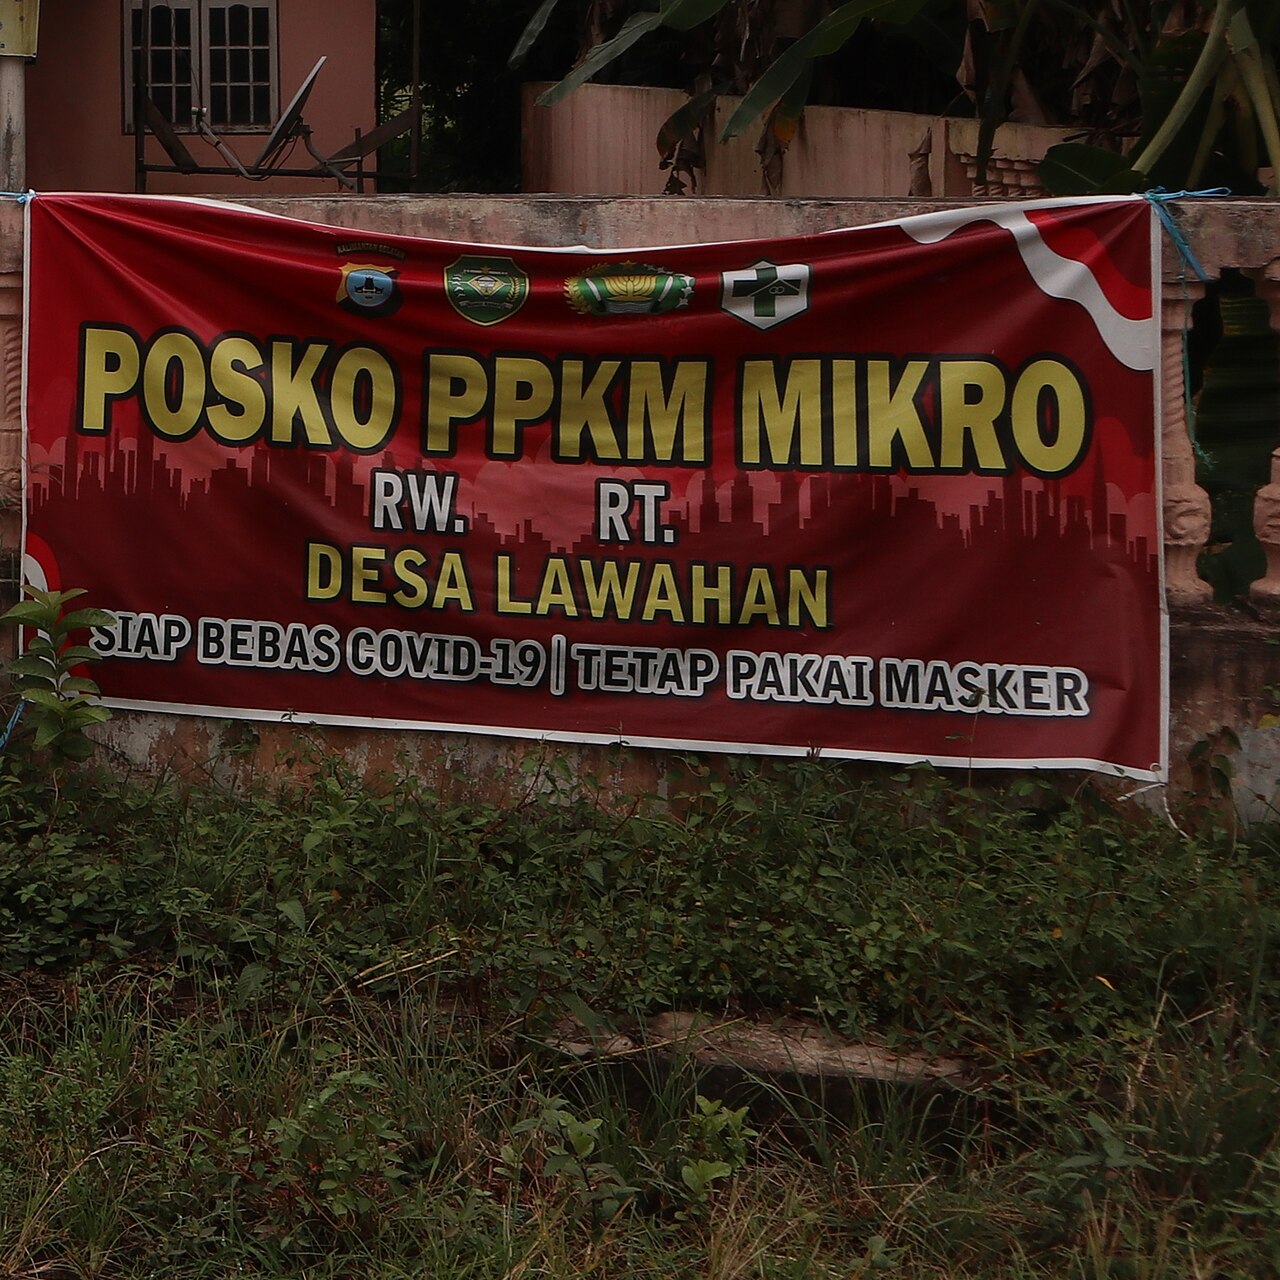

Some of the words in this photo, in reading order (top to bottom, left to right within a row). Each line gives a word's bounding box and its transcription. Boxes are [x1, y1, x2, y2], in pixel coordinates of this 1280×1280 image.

[80, 325, 398, 451] POSKO
[425, 351, 709, 463] PPKM
[740, 358, 1089, 474] MIKRO
[372, 471, 466, 535] RW.
[598, 481, 676, 544] RT.
[306, 541, 475, 613] DESA
[496, 554, 830, 630] LAWAHAN
[91, 612, 192, 661] SIAP
[198, 619, 339, 670] BEBAS
[349, 628, 545, 684] COVID-19
[573, 645, 719, 696] TETAP
[728, 652, 872, 704] PAKAI
[882, 660, 1088, 715] MASKER
